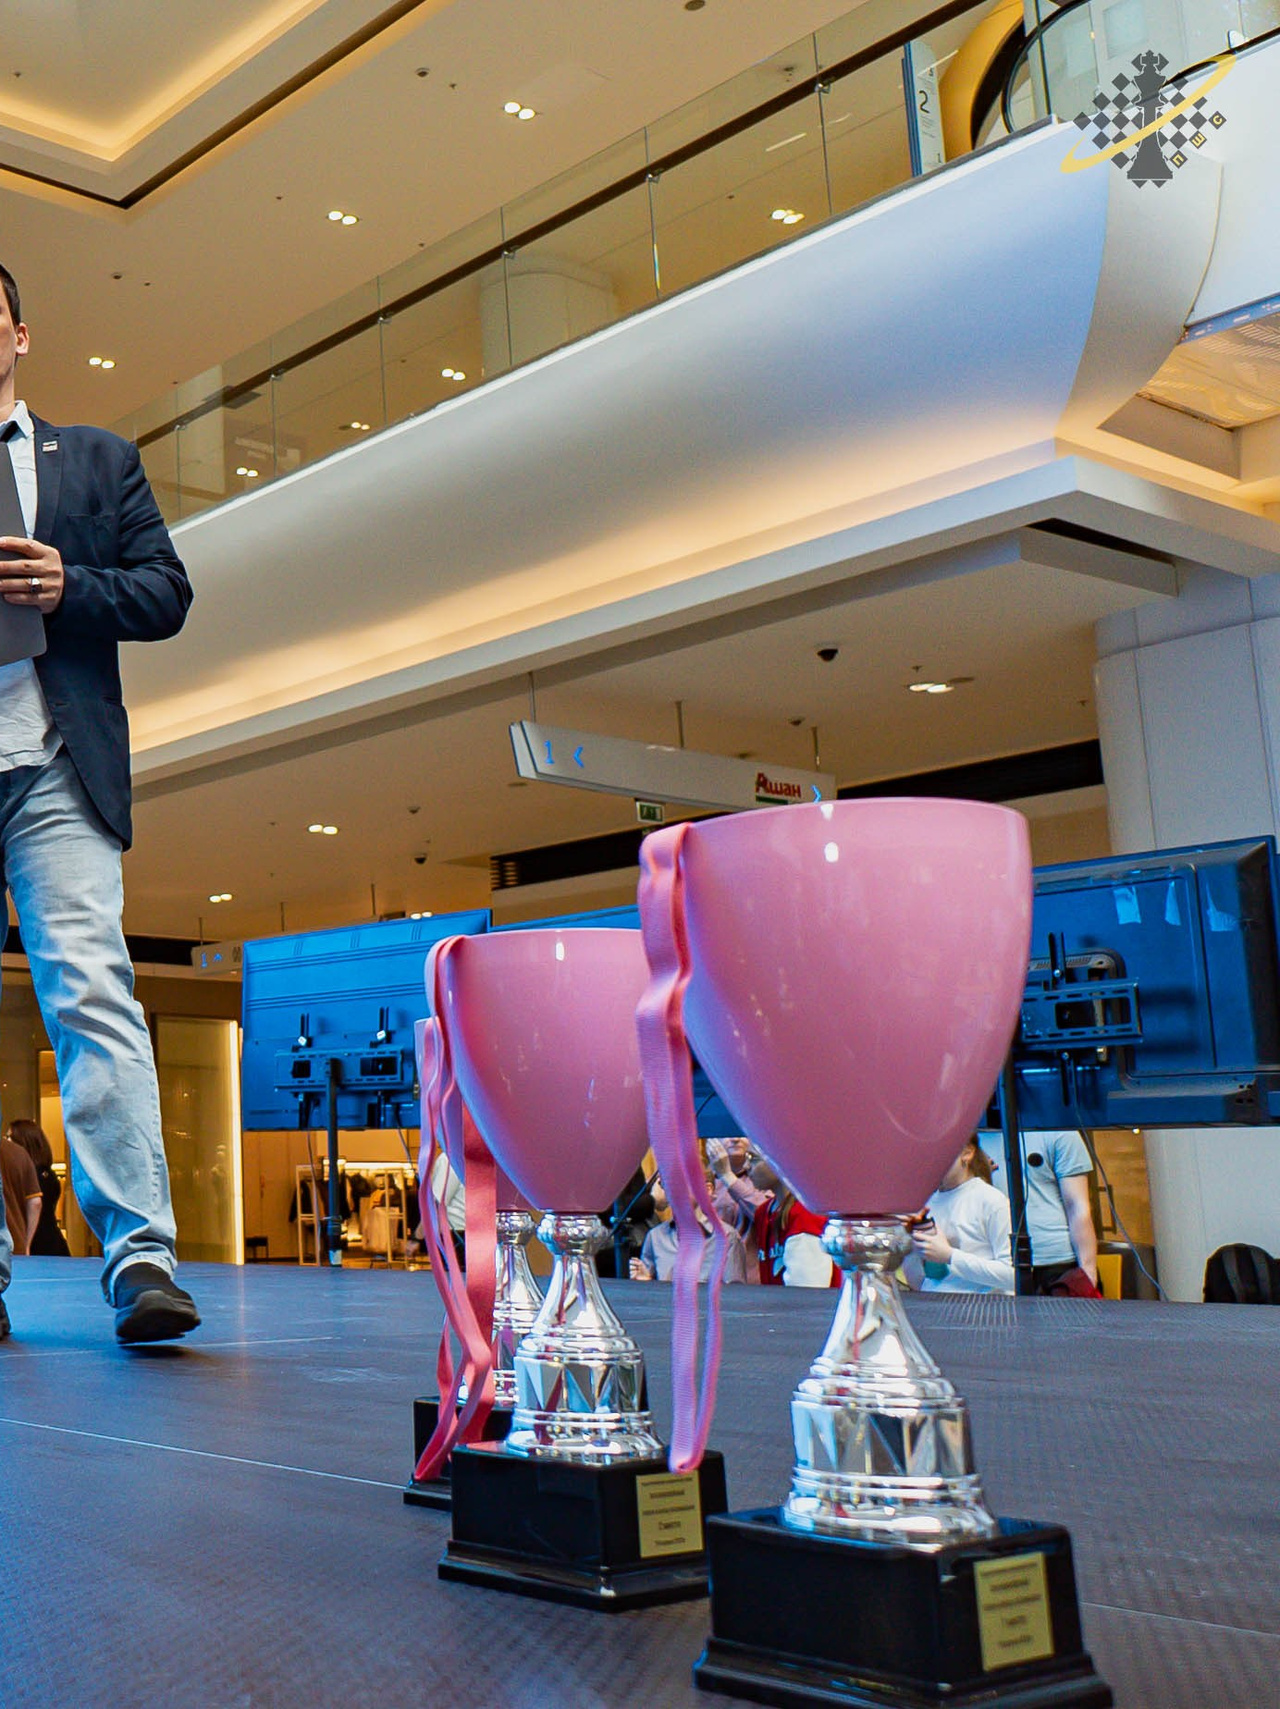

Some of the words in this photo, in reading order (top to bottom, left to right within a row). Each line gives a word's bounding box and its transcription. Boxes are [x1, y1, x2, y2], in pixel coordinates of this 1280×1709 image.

[919, 90, 930, 114] 2
[543, 739, 555, 765] 1
[755, 772, 802, 799] Ашан
